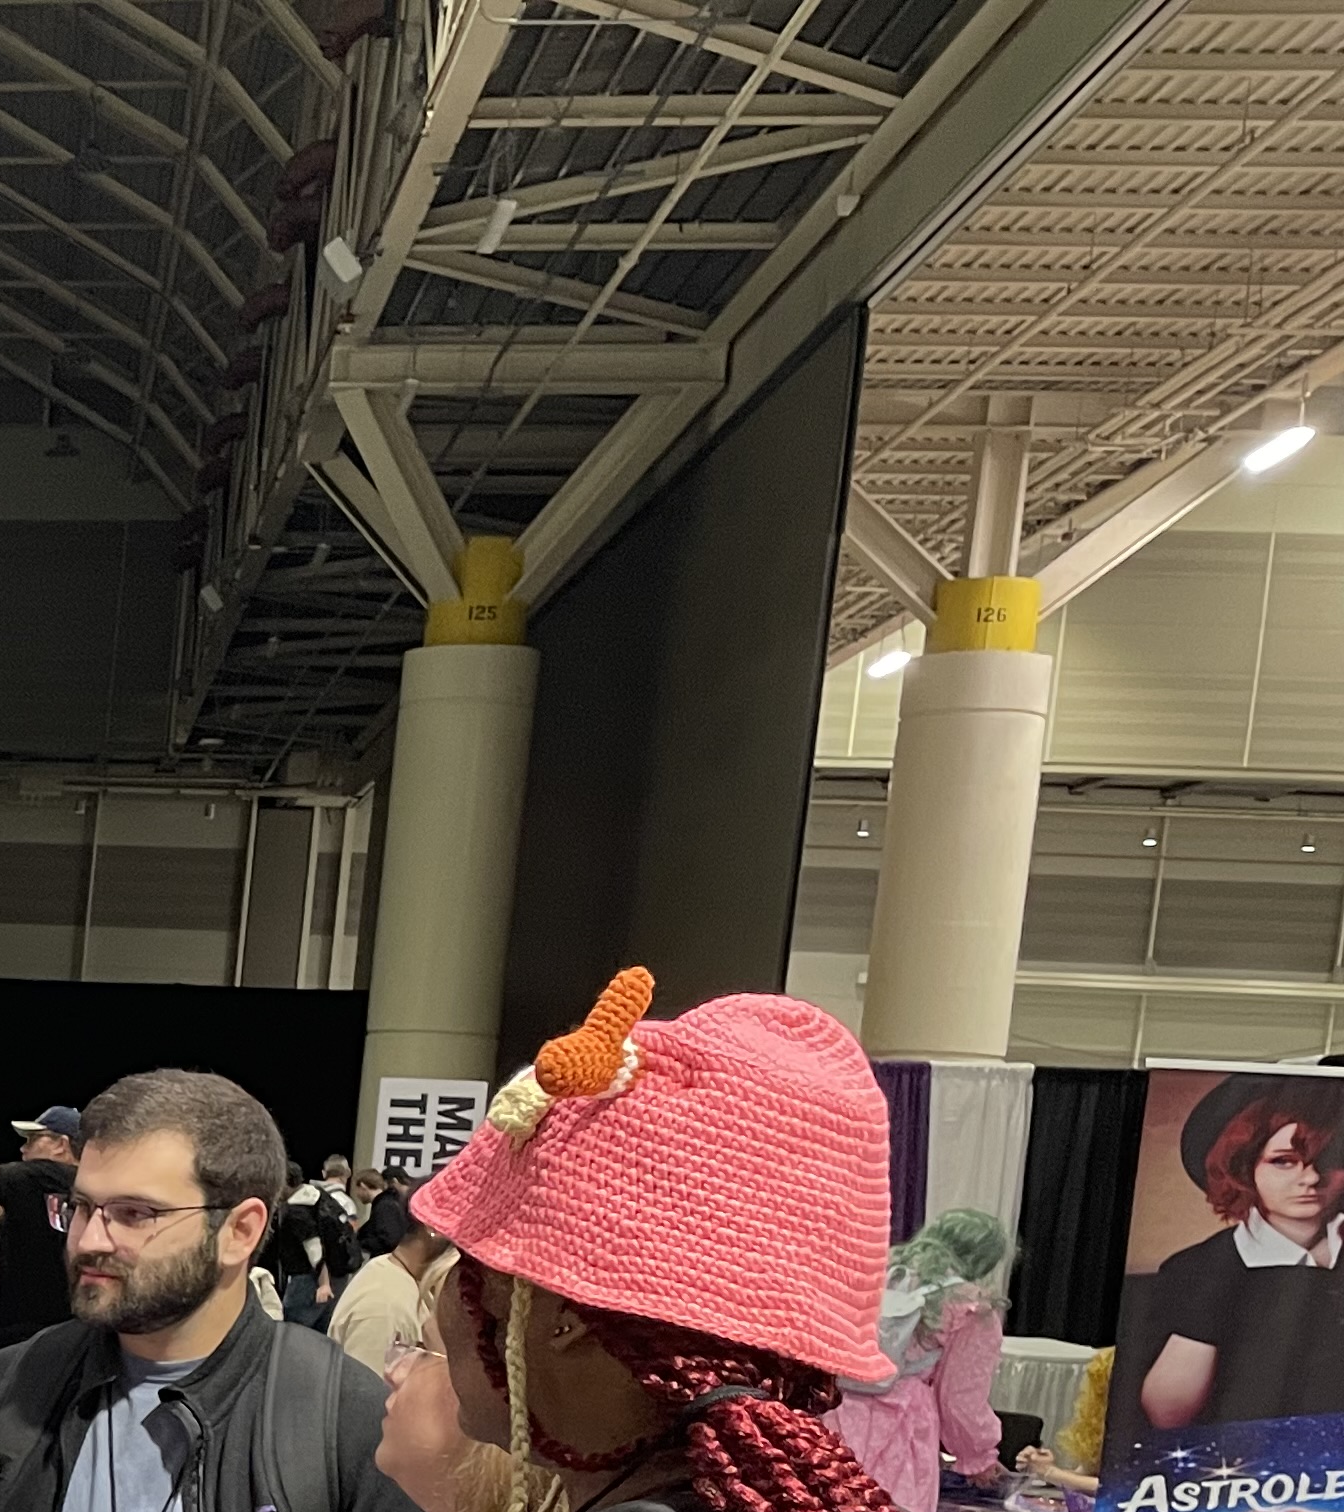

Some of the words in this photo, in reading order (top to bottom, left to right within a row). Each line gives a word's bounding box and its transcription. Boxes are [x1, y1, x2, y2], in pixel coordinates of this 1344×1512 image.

[468, 604, 497, 621] 125
[976, 607, 1007, 623] 126
[384, 1093, 428, 1168] THE
